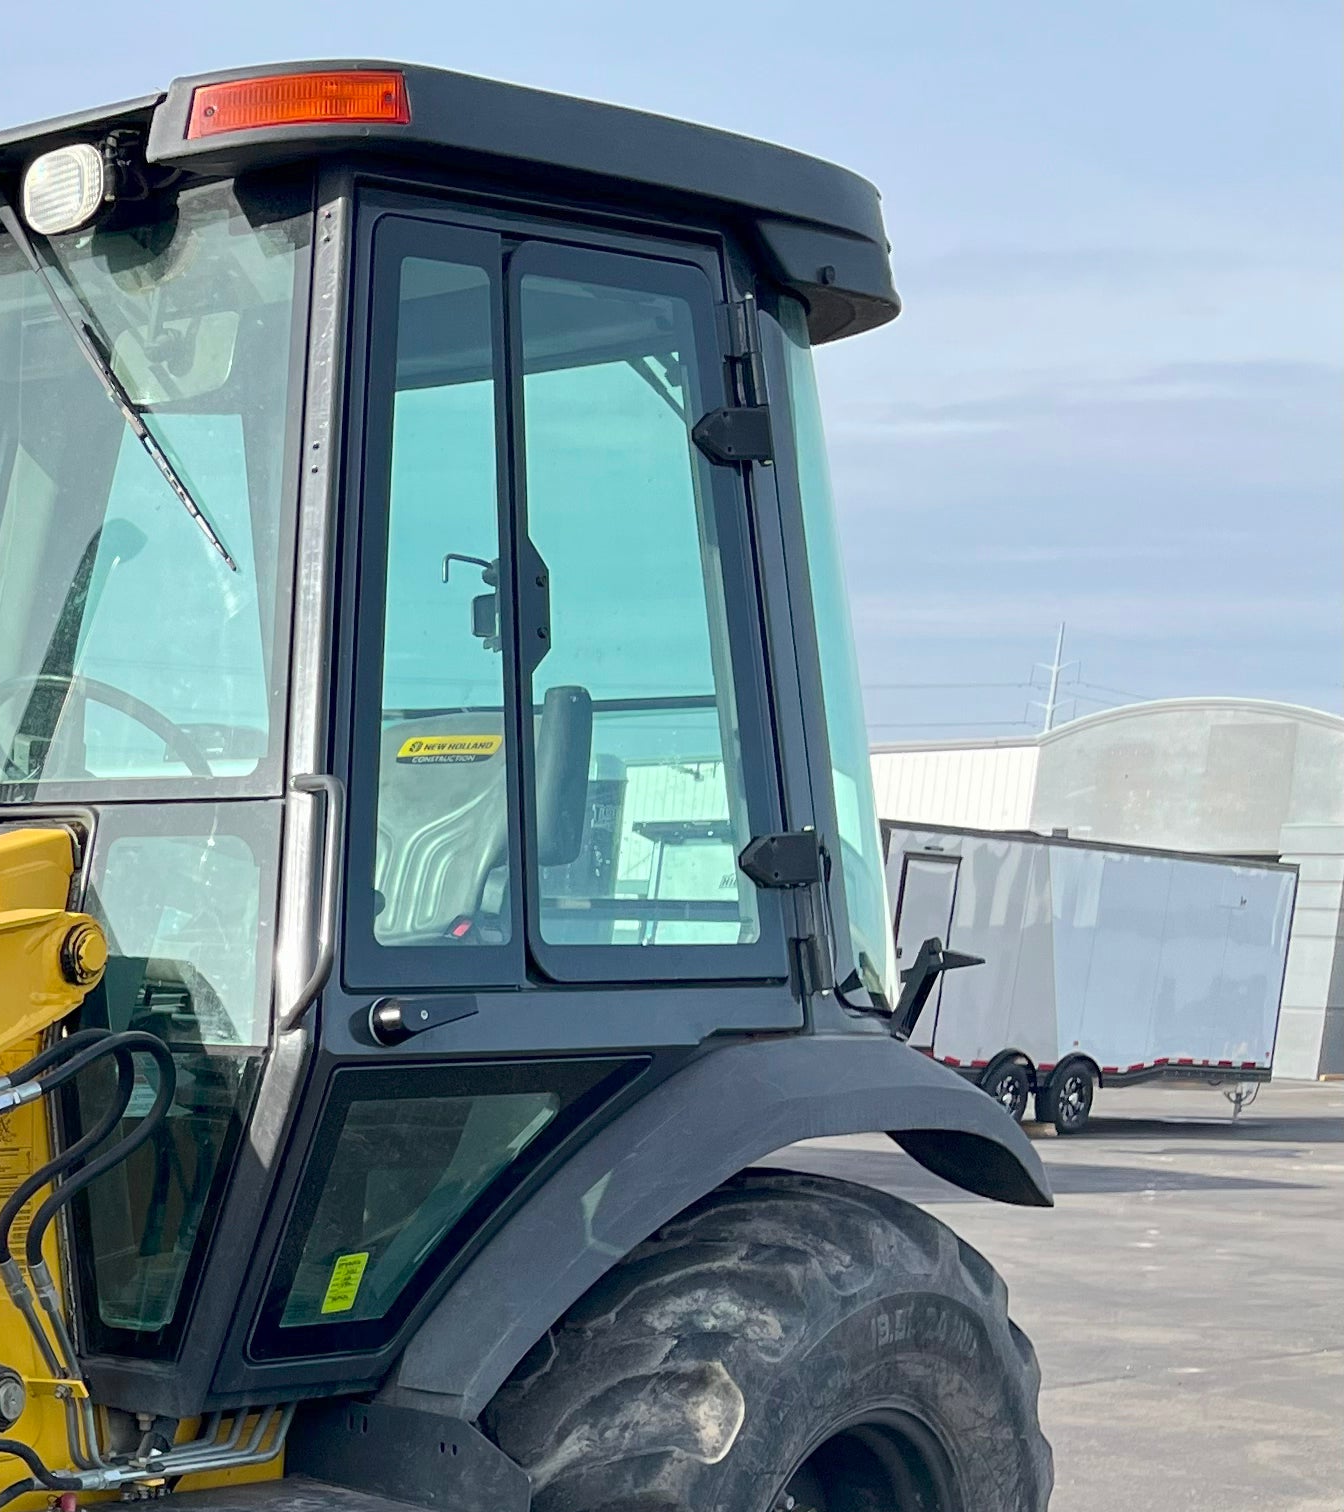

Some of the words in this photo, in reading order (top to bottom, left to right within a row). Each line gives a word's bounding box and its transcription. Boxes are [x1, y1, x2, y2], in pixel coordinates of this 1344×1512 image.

[424, 743, 448, 751] NEW
[448, 742, 494, 750] HOLLAND
[412, 755, 476, 763] CONSTRUCTION
